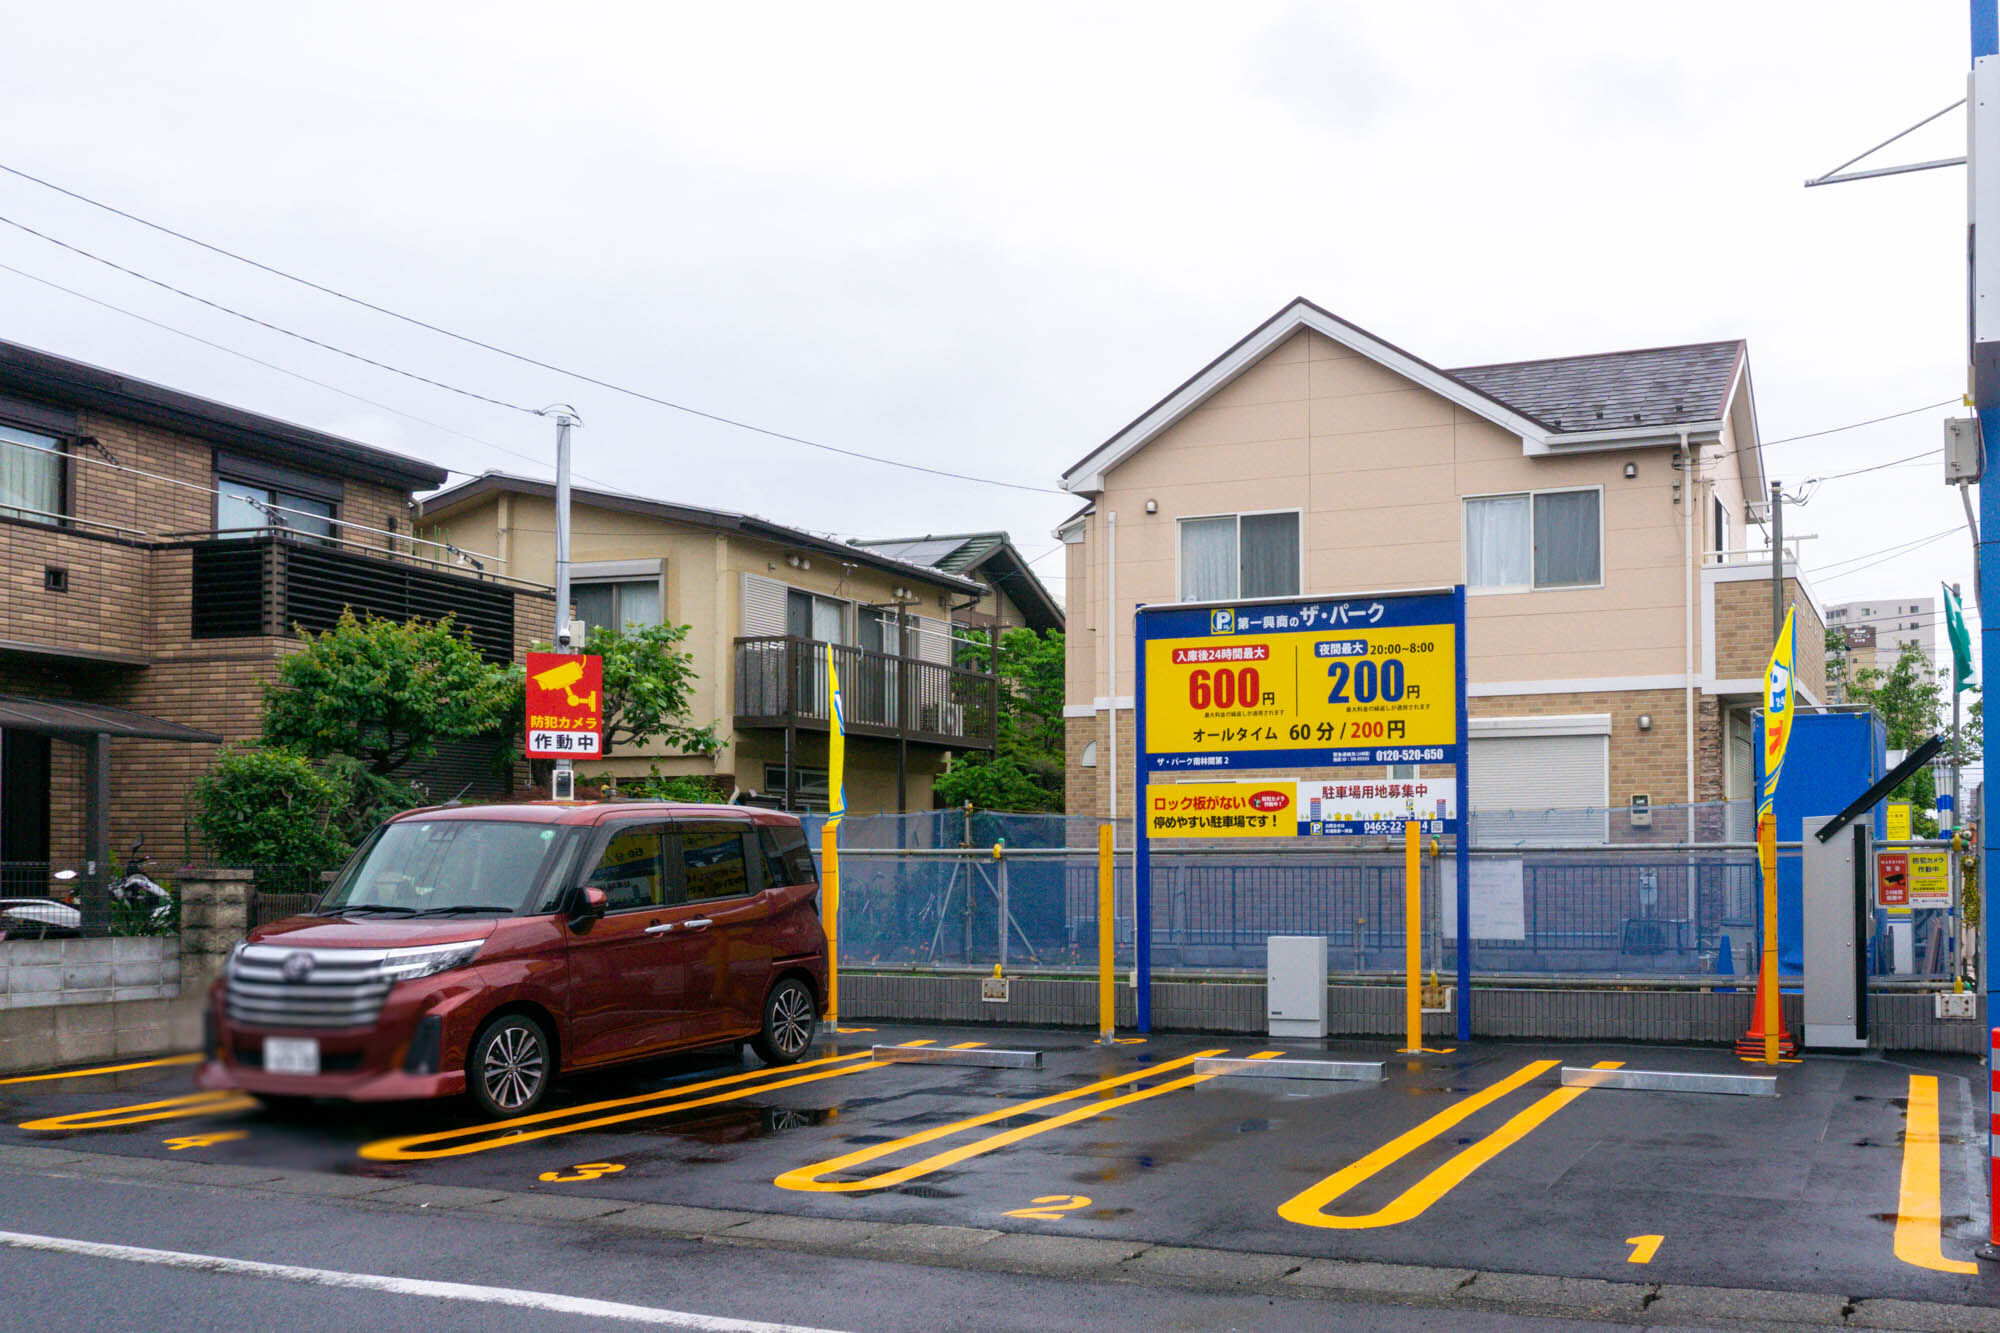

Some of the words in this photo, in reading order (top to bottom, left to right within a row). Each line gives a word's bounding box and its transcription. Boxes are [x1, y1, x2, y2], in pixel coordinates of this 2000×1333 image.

[530, 715, 597, 729] 防犯カメラ
[534, 733, 594, 751] 作動中
[1193, 727, 1278, 743] オールタイム
[1376, 748, 1444, 761] 0120-520-650
[1322, 784, 1428, 800] 駐車場用地募集中
[1154, 796, 1247, 811] ロック板がない
[538, 1162, 627, 1183] 3
[1000, 1194, 1093, 1220] 2
[1625, 1234, 1665, 1264] 1
